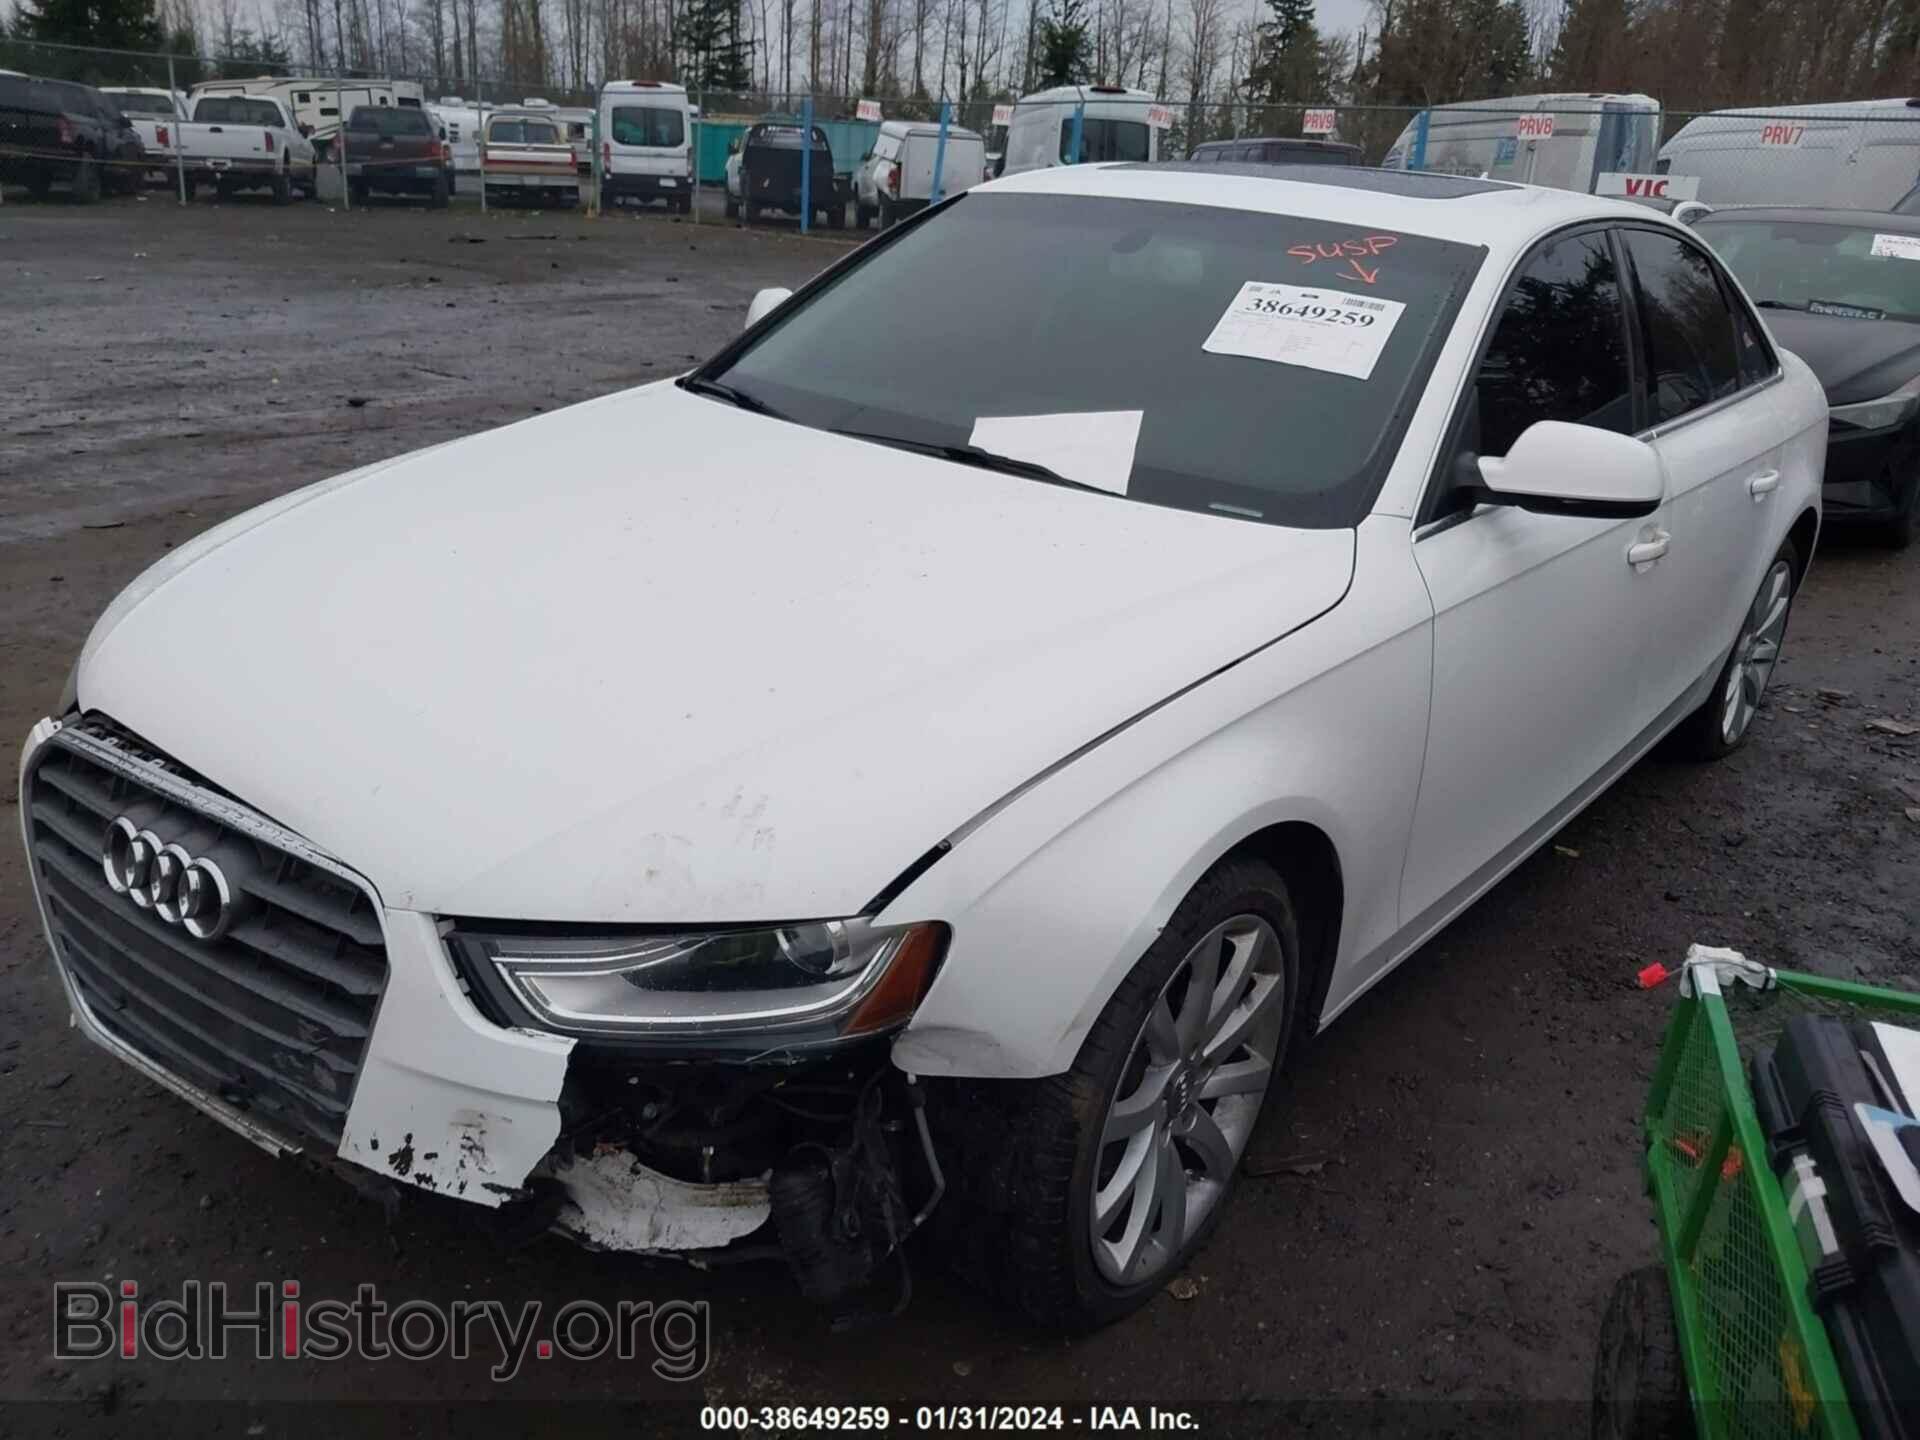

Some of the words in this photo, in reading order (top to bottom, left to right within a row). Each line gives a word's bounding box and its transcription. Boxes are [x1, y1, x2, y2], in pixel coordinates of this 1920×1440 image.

[1304, 113, 1334, 129] PRV9
[1518, 118, 1553, 135] PRV8
[1761, 125, 1804, 145] PRV7
[1625, 178, 1669, 198] VIC
[1287, 236, 1398, 264] SUSP
[1245, 298, 1375, 328] 38649259
